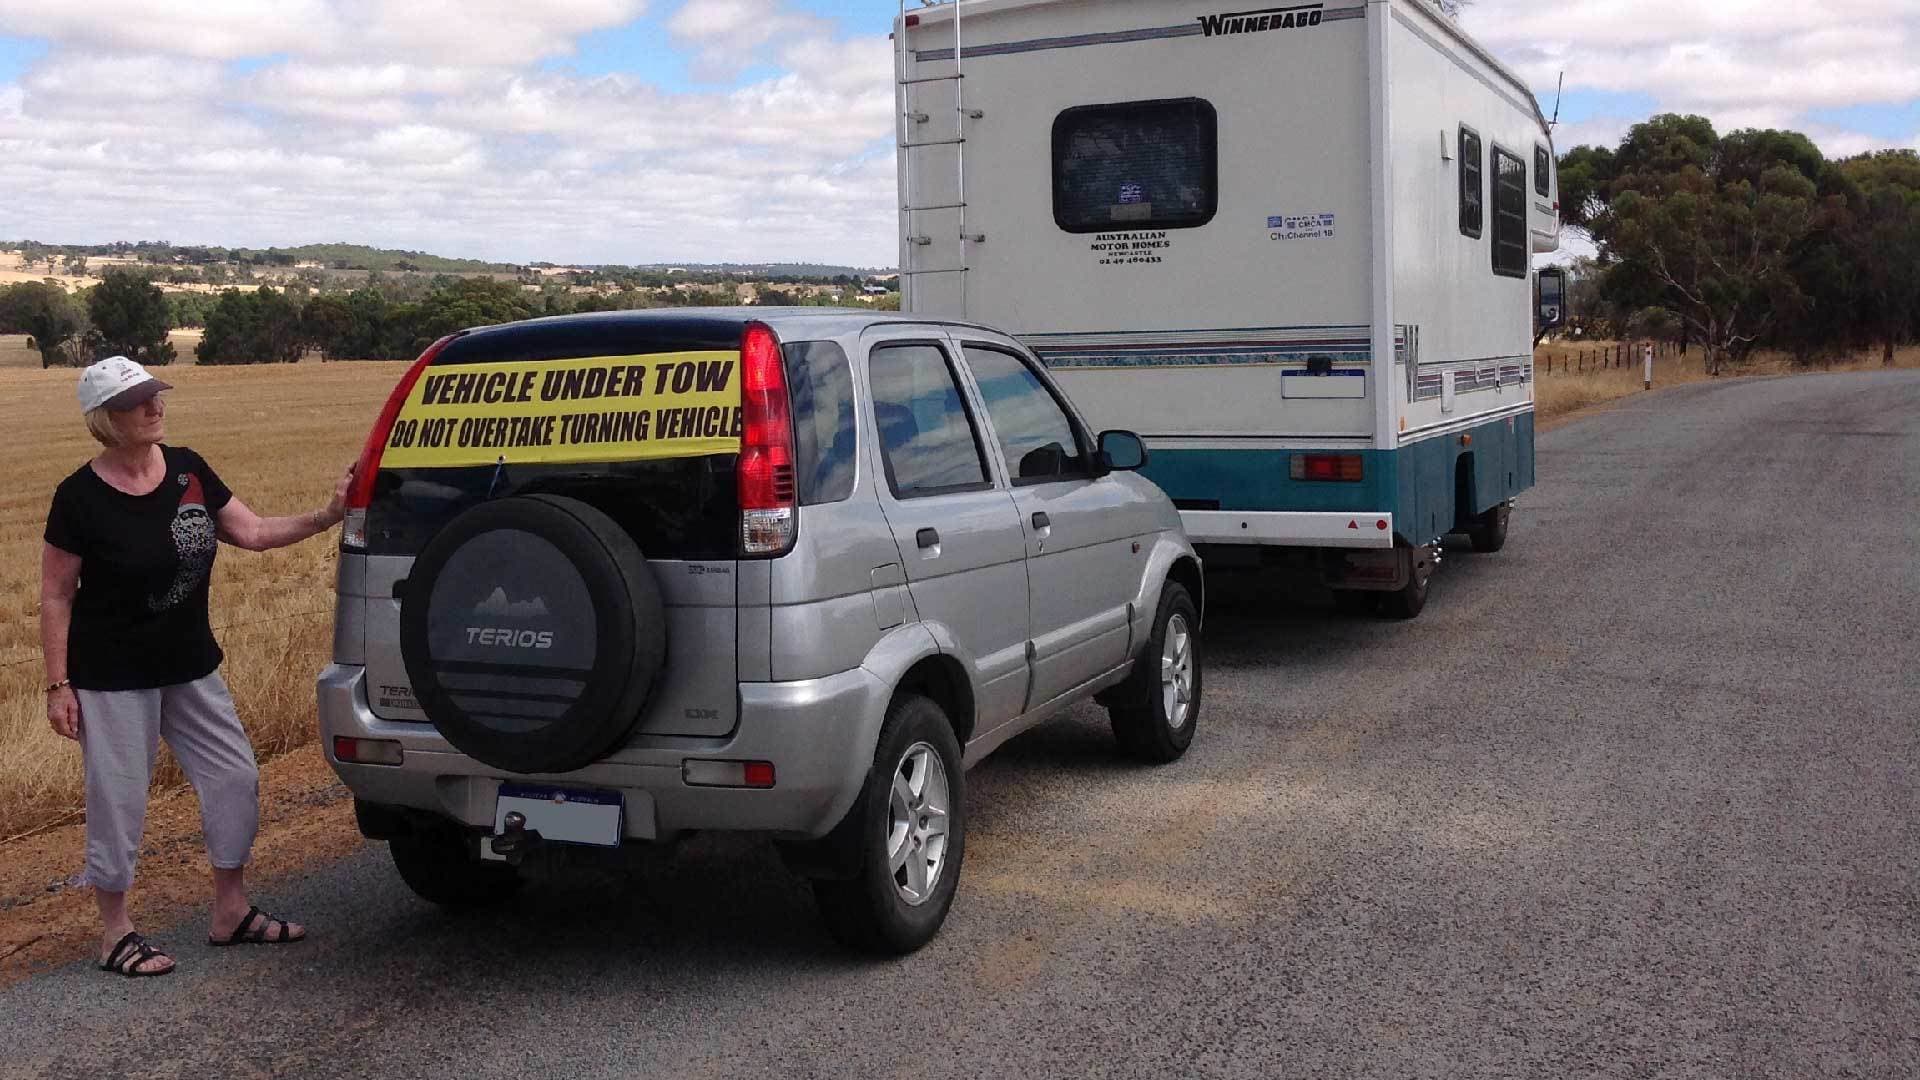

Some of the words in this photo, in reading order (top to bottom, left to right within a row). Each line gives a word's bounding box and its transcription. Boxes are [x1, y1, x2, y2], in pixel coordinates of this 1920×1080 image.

[1197, 3, 1323, 37] WINNEBAGO
[1090, 242, 1129, 251] MOTOR
[1132, 240, 1171, 249] HOMES
[1095, 231, 1166, 241] AUSTRALIAN
[421, 371, 538, 405] VEHICLE
[540, 365, 646, 402] UNDER
[654, 360, 734, 395] TOW
[390, 419, 418, 448] DO
[417, 418, 459, 448] NOT
[458, 416, 556, 447] OVERTAKE
[560, 410, 650, 444] TURNING
[655, 406, 742, 440] VEHICLE
[466, 627, 554, 649] TERIOS
[379, 685, 414, 697] TERI
